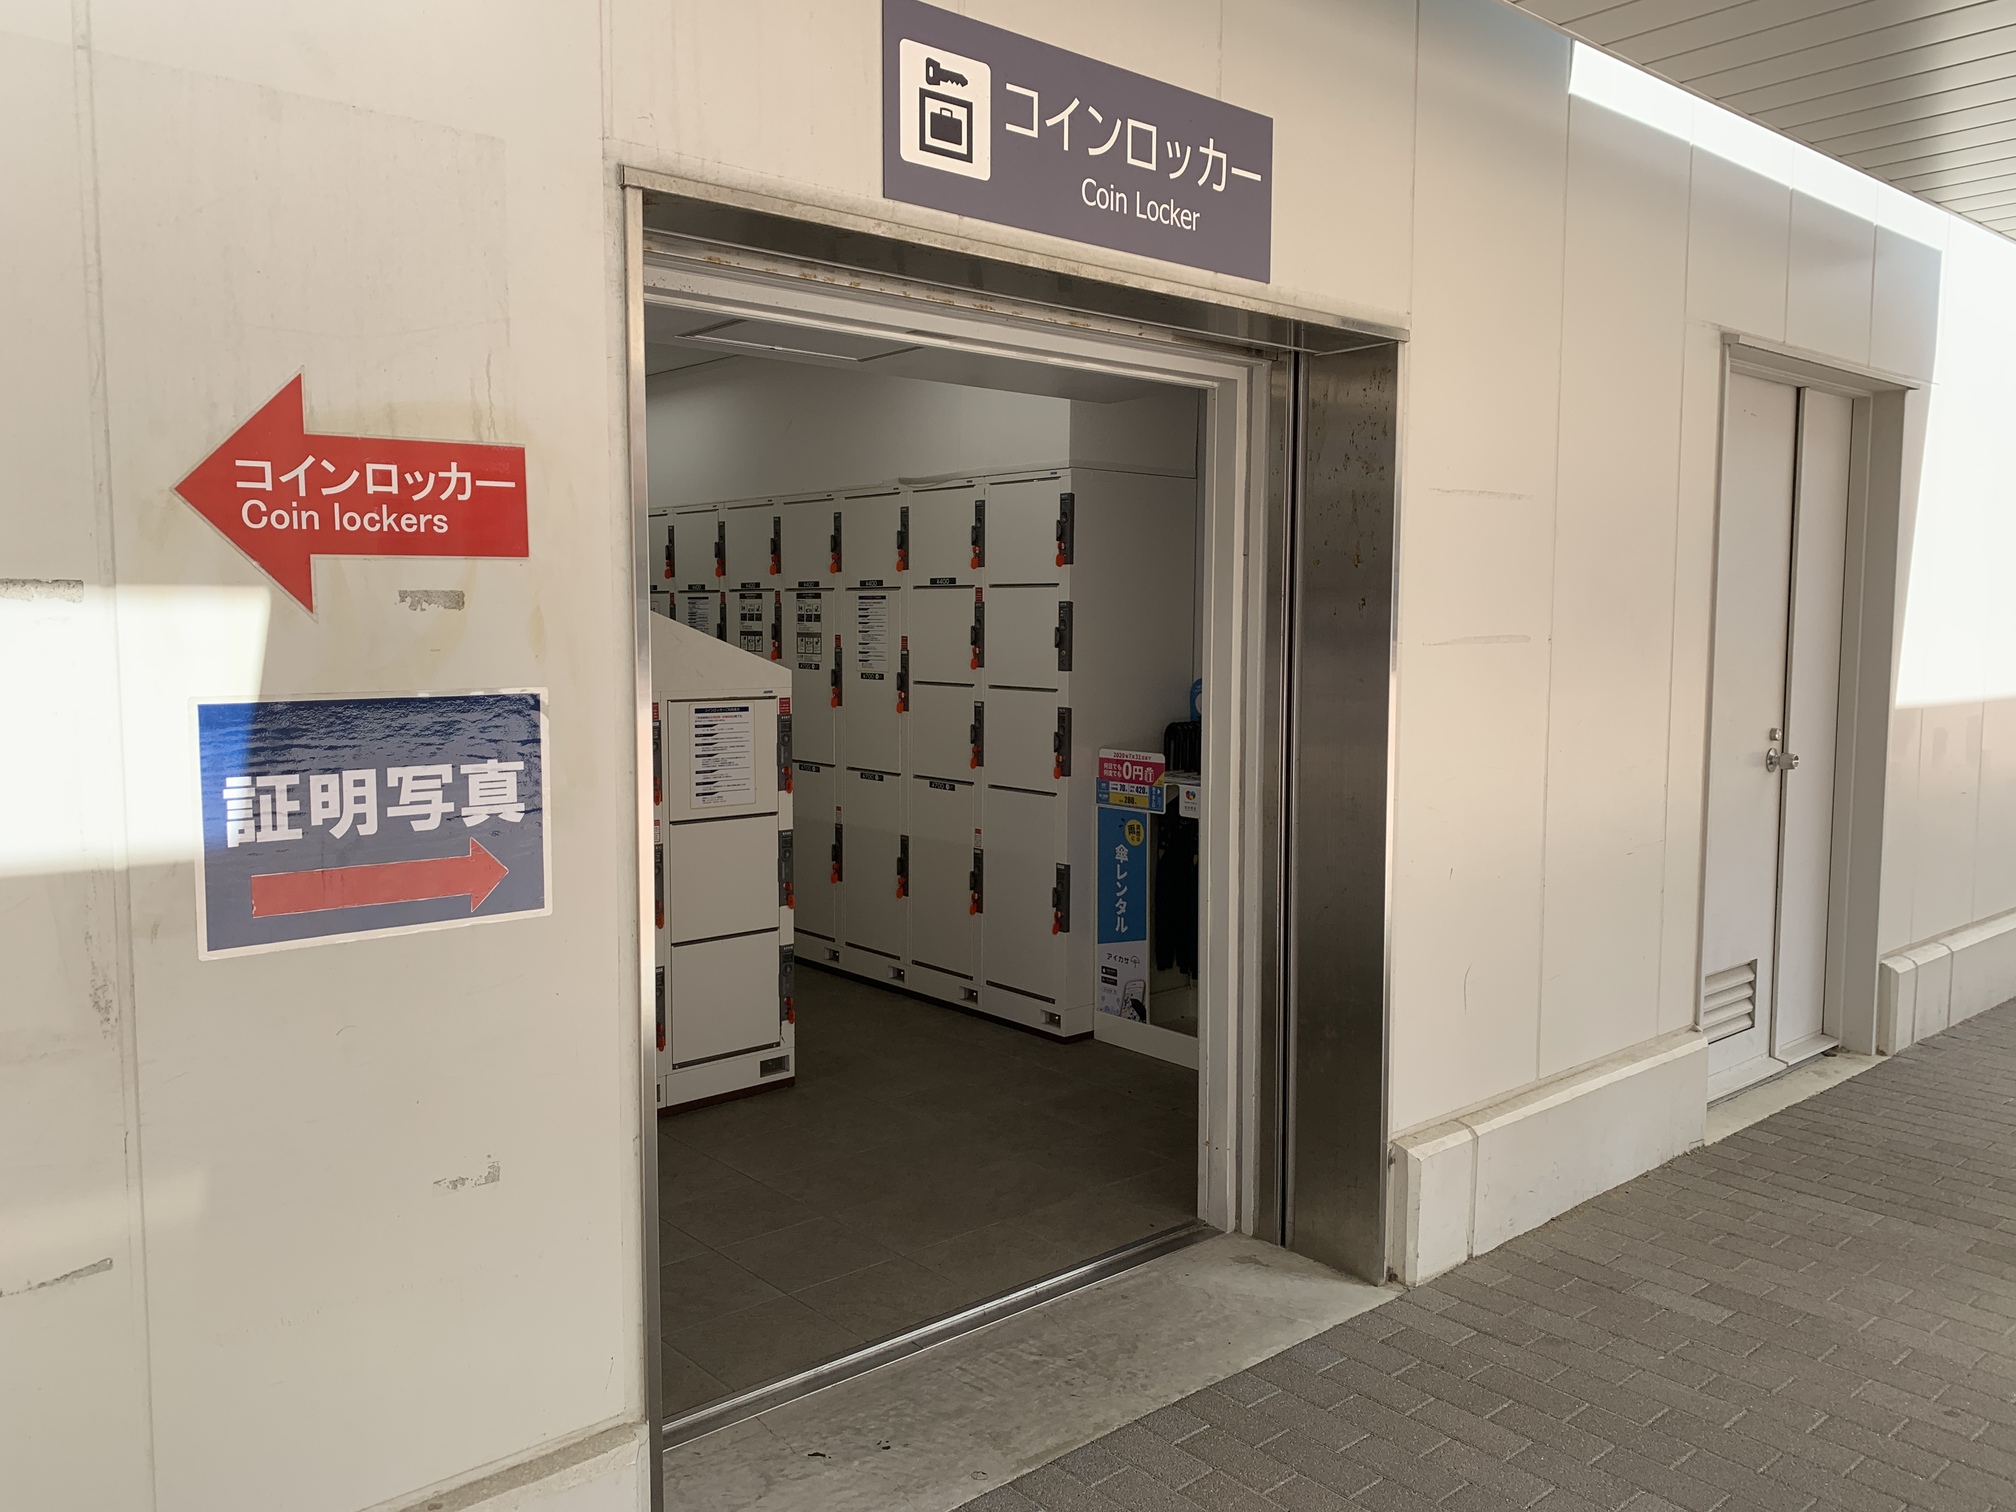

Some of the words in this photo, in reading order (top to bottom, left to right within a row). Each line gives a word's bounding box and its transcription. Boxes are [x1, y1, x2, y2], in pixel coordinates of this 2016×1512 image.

[1005, 82, 1261, 192] コインロッカー
[1081, 177, 1128, 214] Coin
[1135, 191, 1200, 231] Locker
[235, 454, 516, 501] コインロッカー
[241, 499, 320, 531] Coin
[333, 502, 448, 533] lockers
[1122, 761, 1143, 781] 0円
[222, 759, 526, 848] 証明写真
[1114, 843, 1129, 933] 傘レンタル
[1106, 953, 1130, 965] アイカサ
